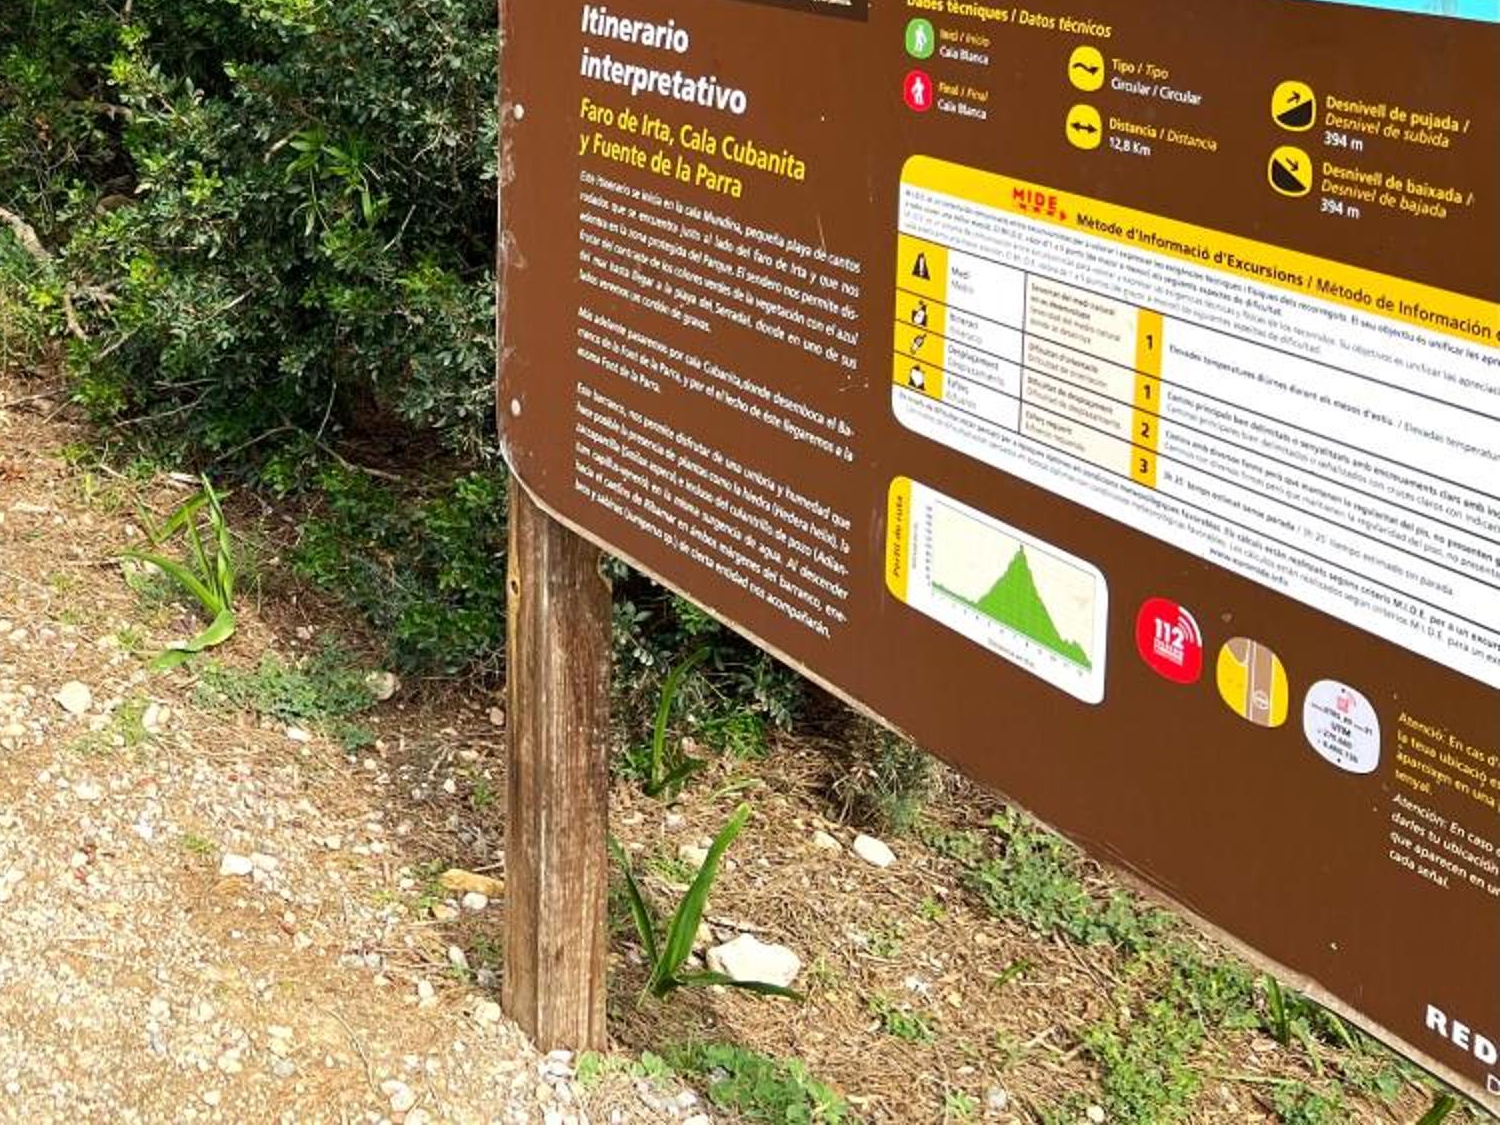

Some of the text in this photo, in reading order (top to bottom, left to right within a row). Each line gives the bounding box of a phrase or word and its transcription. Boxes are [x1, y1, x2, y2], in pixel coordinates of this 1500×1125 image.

[581, 6, 689, 52] Itinerario
[946, 0, 1008, 21] tècniques
[1011, 8, 1017, 22] /
[1019, 10, 1056, 29] Datos
[1059, 17, 1112, 38] técnicos
[939, 45, 989, 65] Cala Blanca
[1112, 58, 1135, 74] Tipo
[1146, 64, 1169, 80] Tipo
[580, 48, 747, 113] interpretativo
[938, 82, 989, 102] Final Final
[1111, 77, 1151, 95] Circular
[1159, 86, 1202, 105] Circular
[937, 99, 987, 119] Cala Blanca
[1326, 95, 1470, 133] Desnivell de pujada /
[580, 98, 805, 180] Faro de Irta, Cala Cubanita
[1109, 117, 1157, 138] Distancia
[1166, 129, 1217, 151] Distancia
[1324, 131, 1363, 151] 394 m
[1325, 112, 1450, 148] Desnivel de subida
[1109, 137, 1151, 156] 12,8 Km
[579, 133, 742, 197] y Fuente de la Parra
[1322, 162, 1383, 186] Desnivell
[1385, 175, 1403, 191] de
[1406, 179, 1463, 203] baixada
[1012, 186, 1059, 213] MIDE
[1321, 179, 1447, 218] Desnivel de bajada
[1321, 198, 1360, 219] 394 m
[785, 239, 860, 273] playa de cantos
[819, 275, 859, 298] que nos
[1077, 213, 1123, 237] Mètode
[1126, 227, 1210, 260] d'Informació
[1214, 251, 1303, 286] d'Excursions
[1316, 278, 1372, 306] Método
[1376, 295, 1395, 312] de
[1399, 301, 1491, 339] Información
[783, 286, 839, 314] nos permite
[825, 324, 836, 336] el
[834, 324, 859, 345] azul
[1146, 334, 1153, 350] 1
[787, 334, 857, 369] en uno de sus
[1144, 384, 1151, 400] 1
[1140, 422, 1150, 438] 2
[1139, 458, 1149, 474] 3
[1155, 618, 1185, 651] 112
[1449, 735, 1463, 751] En
[1466, 747, 1485, 762] cas
[1439, 753, 1487, 786] ubicació
[1454, 781, 1470, 794] en
[1391, 813, 1499, 875] darles tu ubicación
[1449, 822, 1465, 838] En
[1467, 833, 1494, 852] caso
[1389, 850, 1415, 870] cada
[1390, 832, 1485, 888] que aparecen en
[1425, 1003, 1497, 1066] RED
